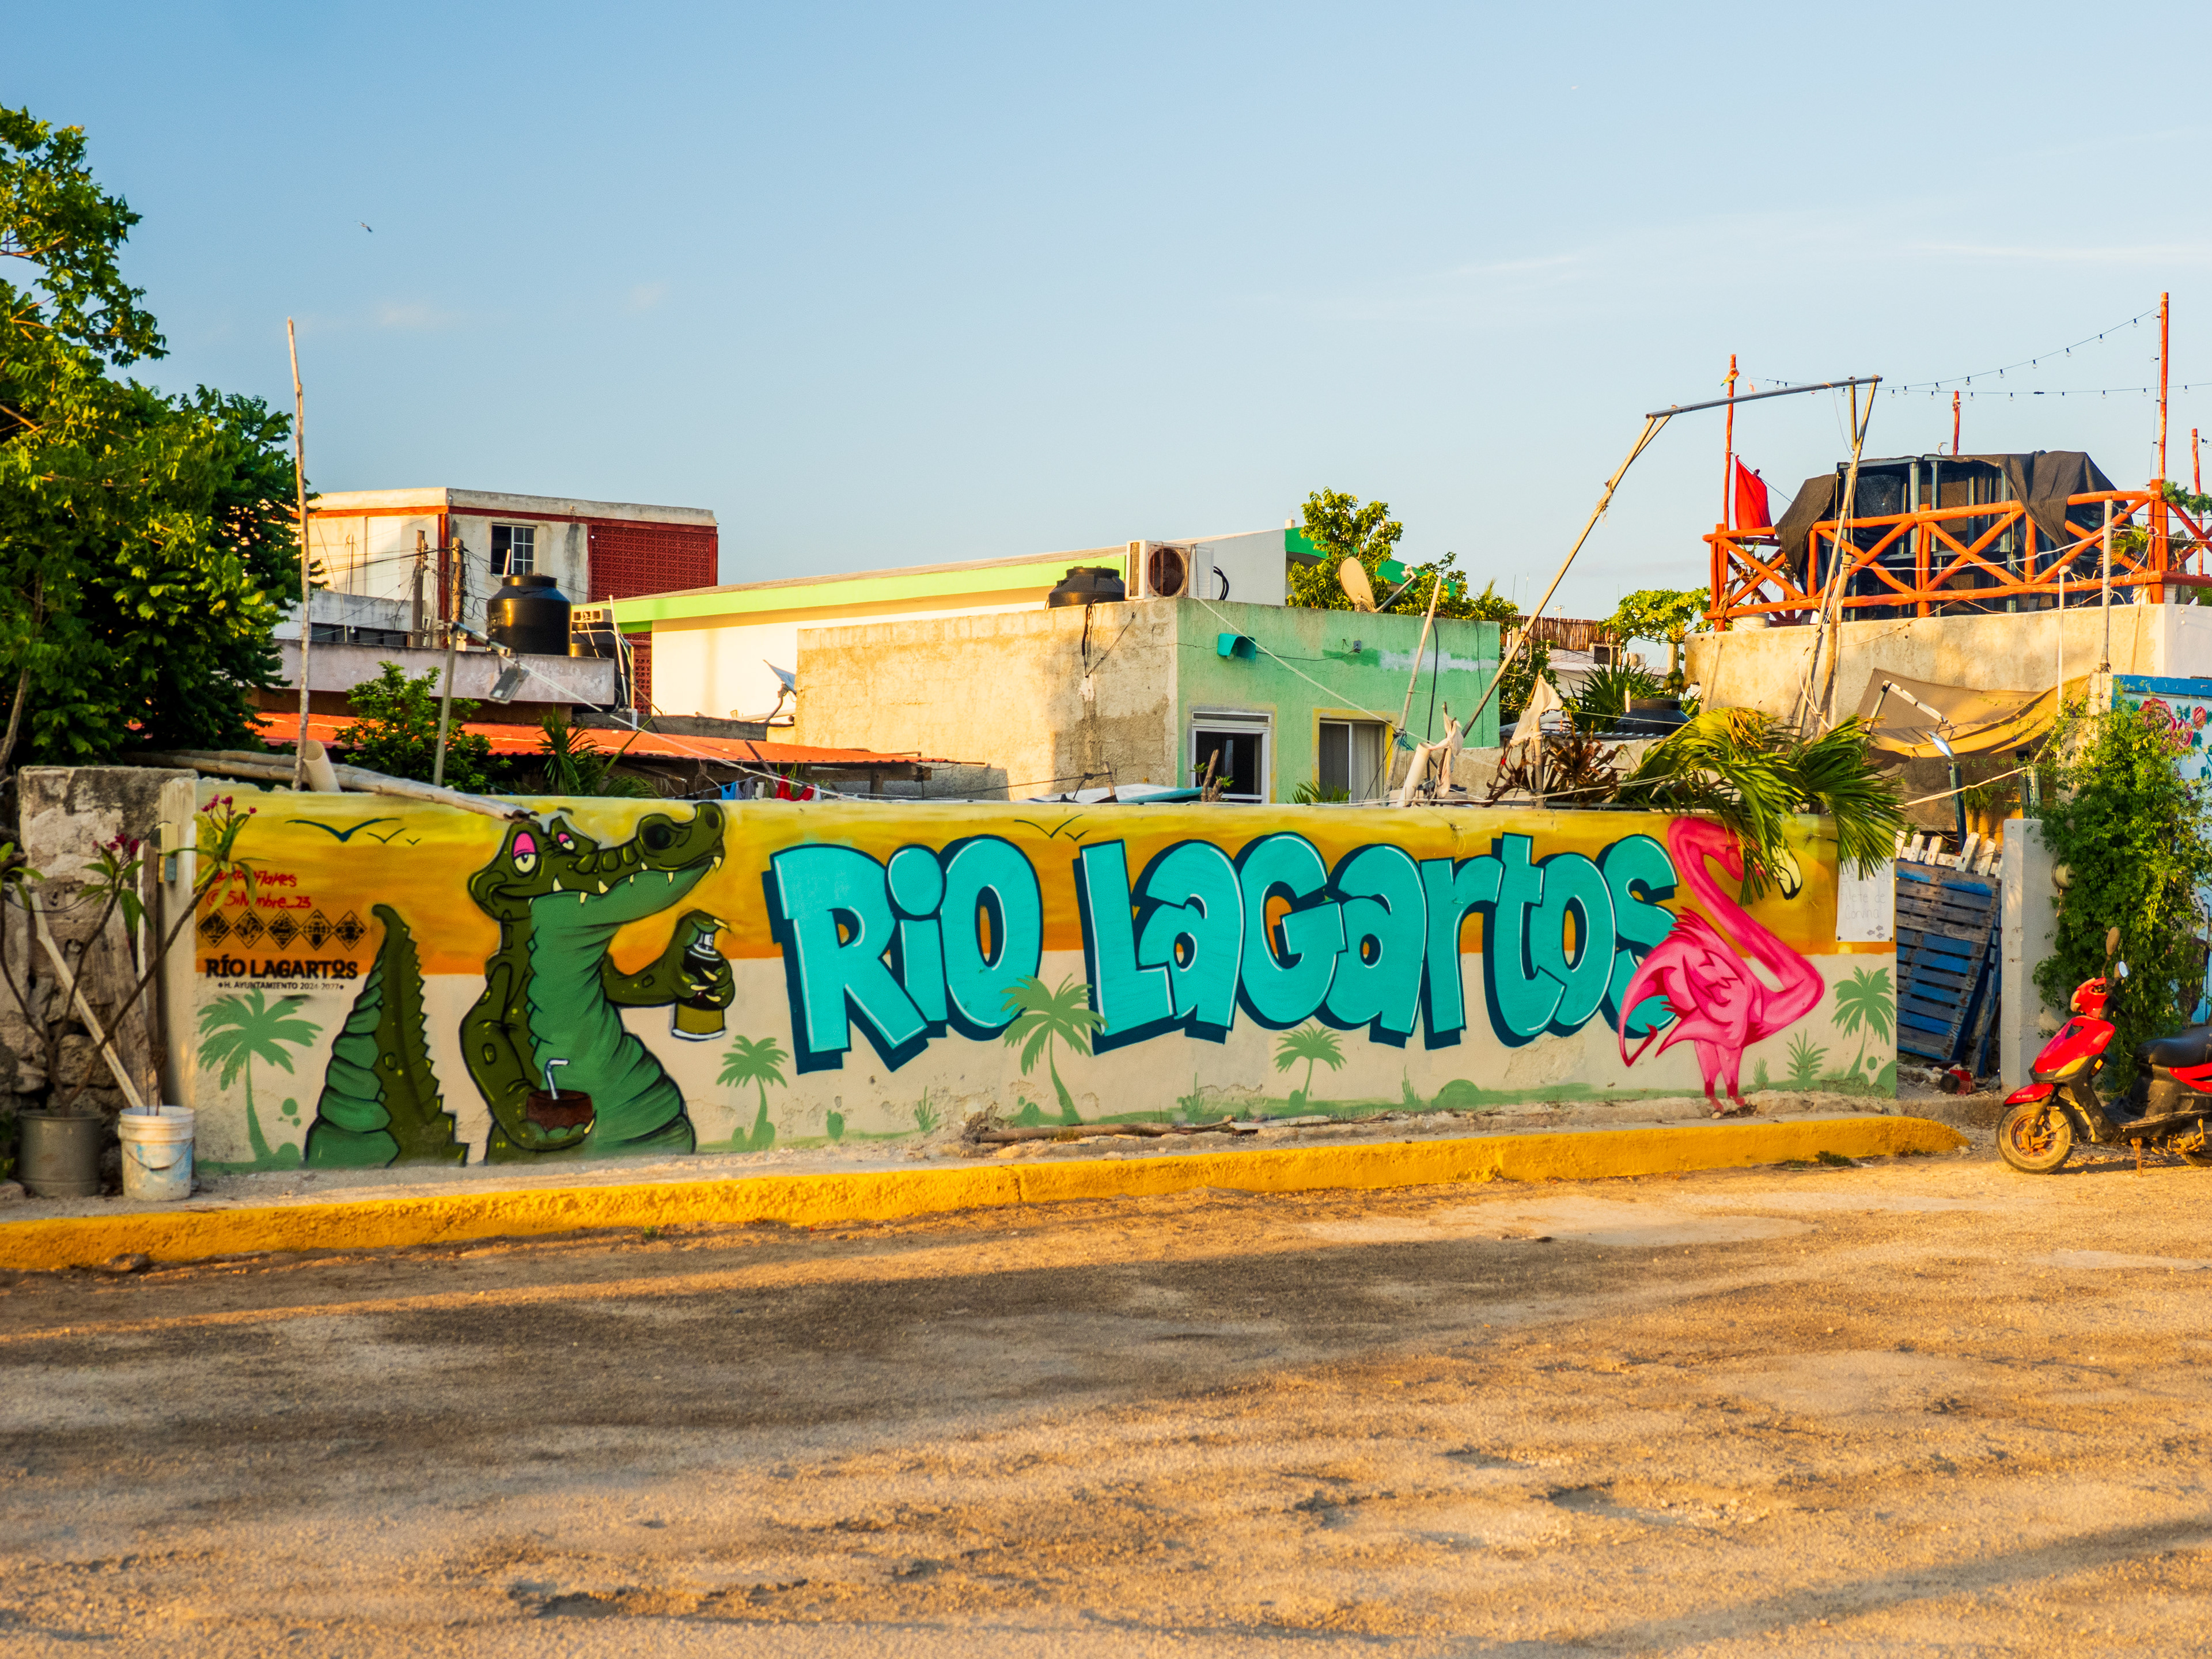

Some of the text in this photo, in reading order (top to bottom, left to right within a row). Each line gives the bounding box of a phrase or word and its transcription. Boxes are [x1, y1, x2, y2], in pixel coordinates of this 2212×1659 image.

[205, 954, 358, 979] RÍO LAGARTOS
[233, 981, 298, 990] AYUNTAMIENTO
